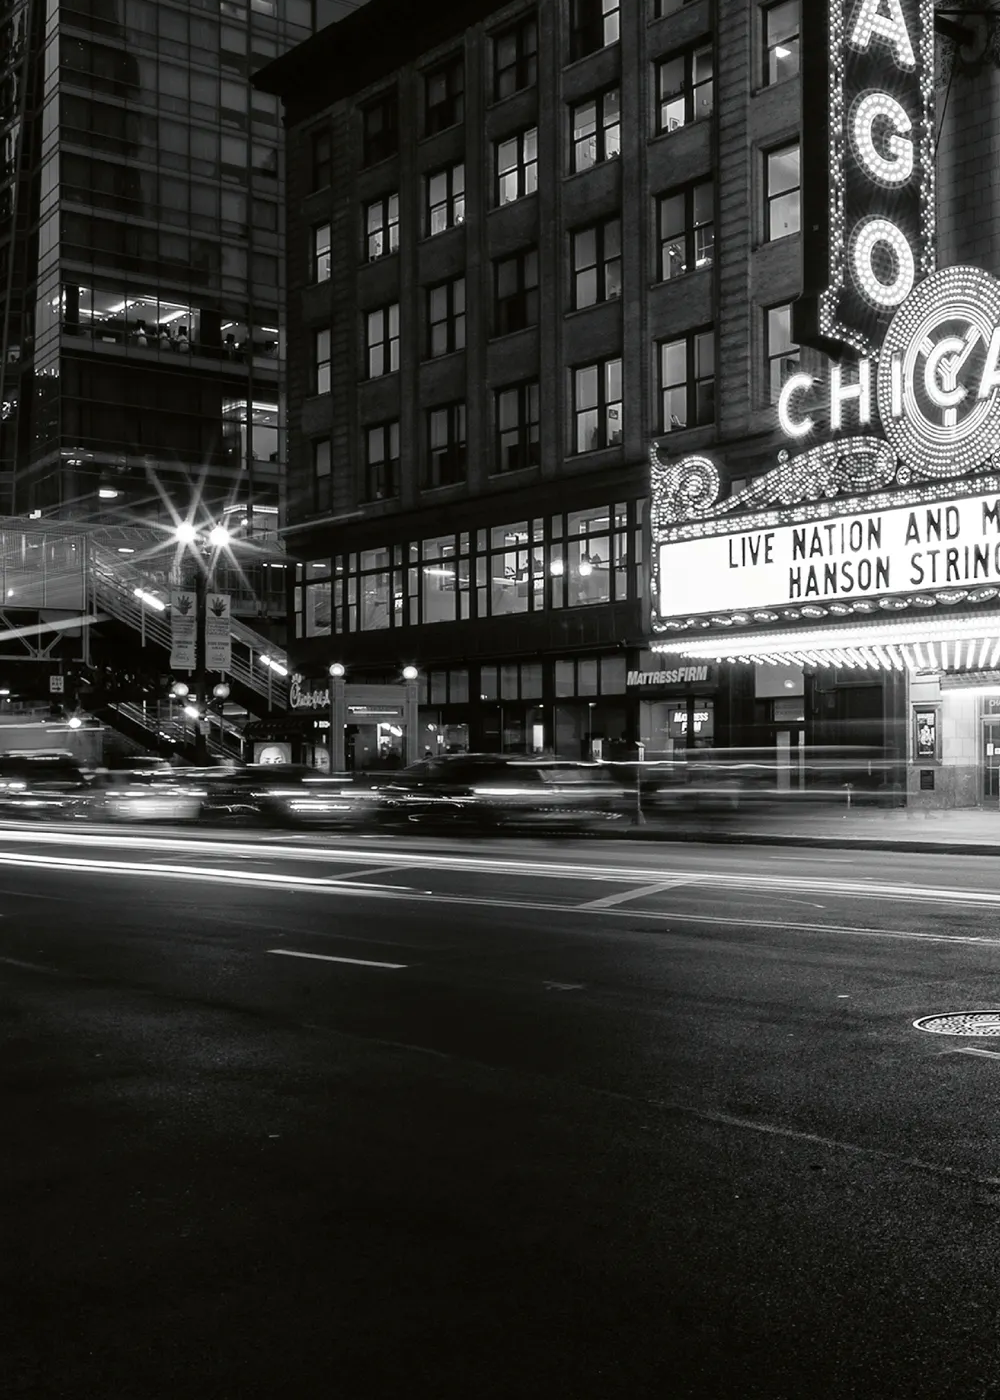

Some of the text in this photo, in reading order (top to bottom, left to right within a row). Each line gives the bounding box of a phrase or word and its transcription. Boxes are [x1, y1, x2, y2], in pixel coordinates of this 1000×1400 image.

[728, 532, 776, 569] LIVE
[792, 516, 882, 561] NATION
[905, 505, 960, 546] AND
[789, 555, 890, 599] HANSON
